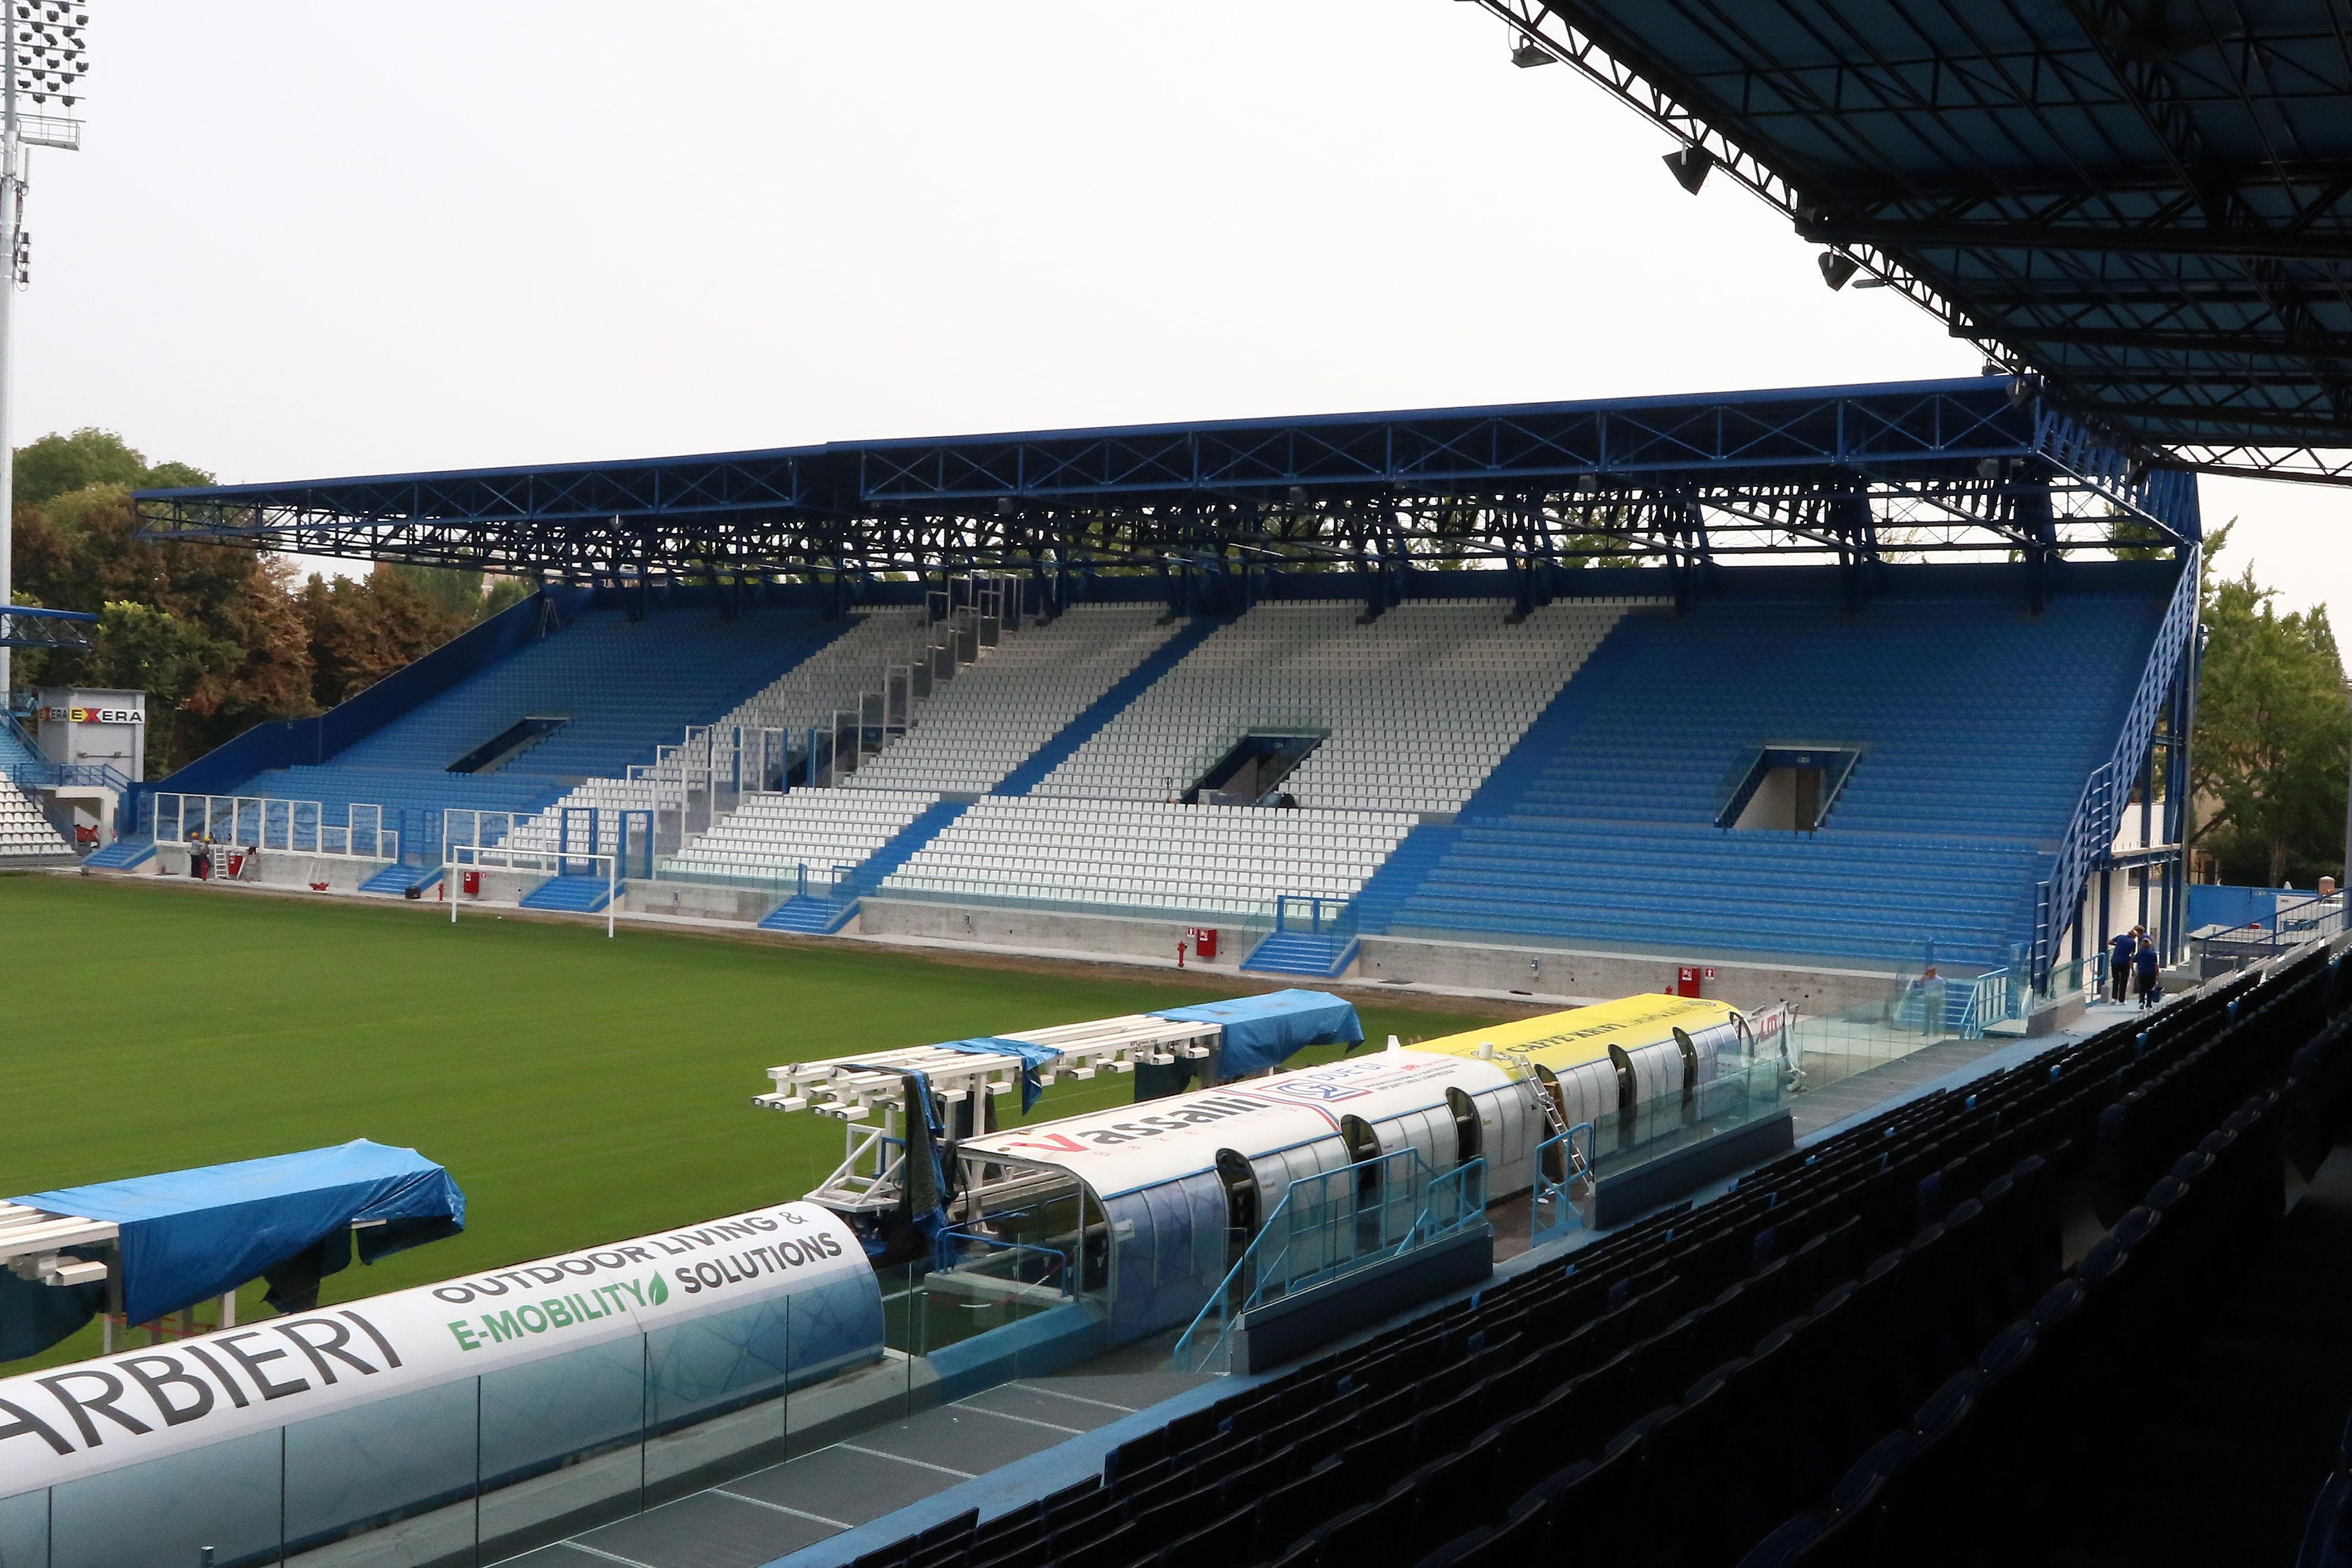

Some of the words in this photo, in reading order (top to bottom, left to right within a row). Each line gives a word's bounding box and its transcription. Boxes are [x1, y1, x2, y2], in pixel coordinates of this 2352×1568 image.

[71, 708, 142, 724] EXERA
[1307, 1068, 1363, 1081] DUE
[1007, 1096, 1272, 1152] Vassalli
[432, 1245, 657, 1304] OUTDOOR
[651, 1216, 779, 1255] LIVING
[779, 1211, 809, 1225] &
[447, 1279, 647, 1351] E-MOBILITY
[675, 1233, 842, 1294] SOLUTIONS
